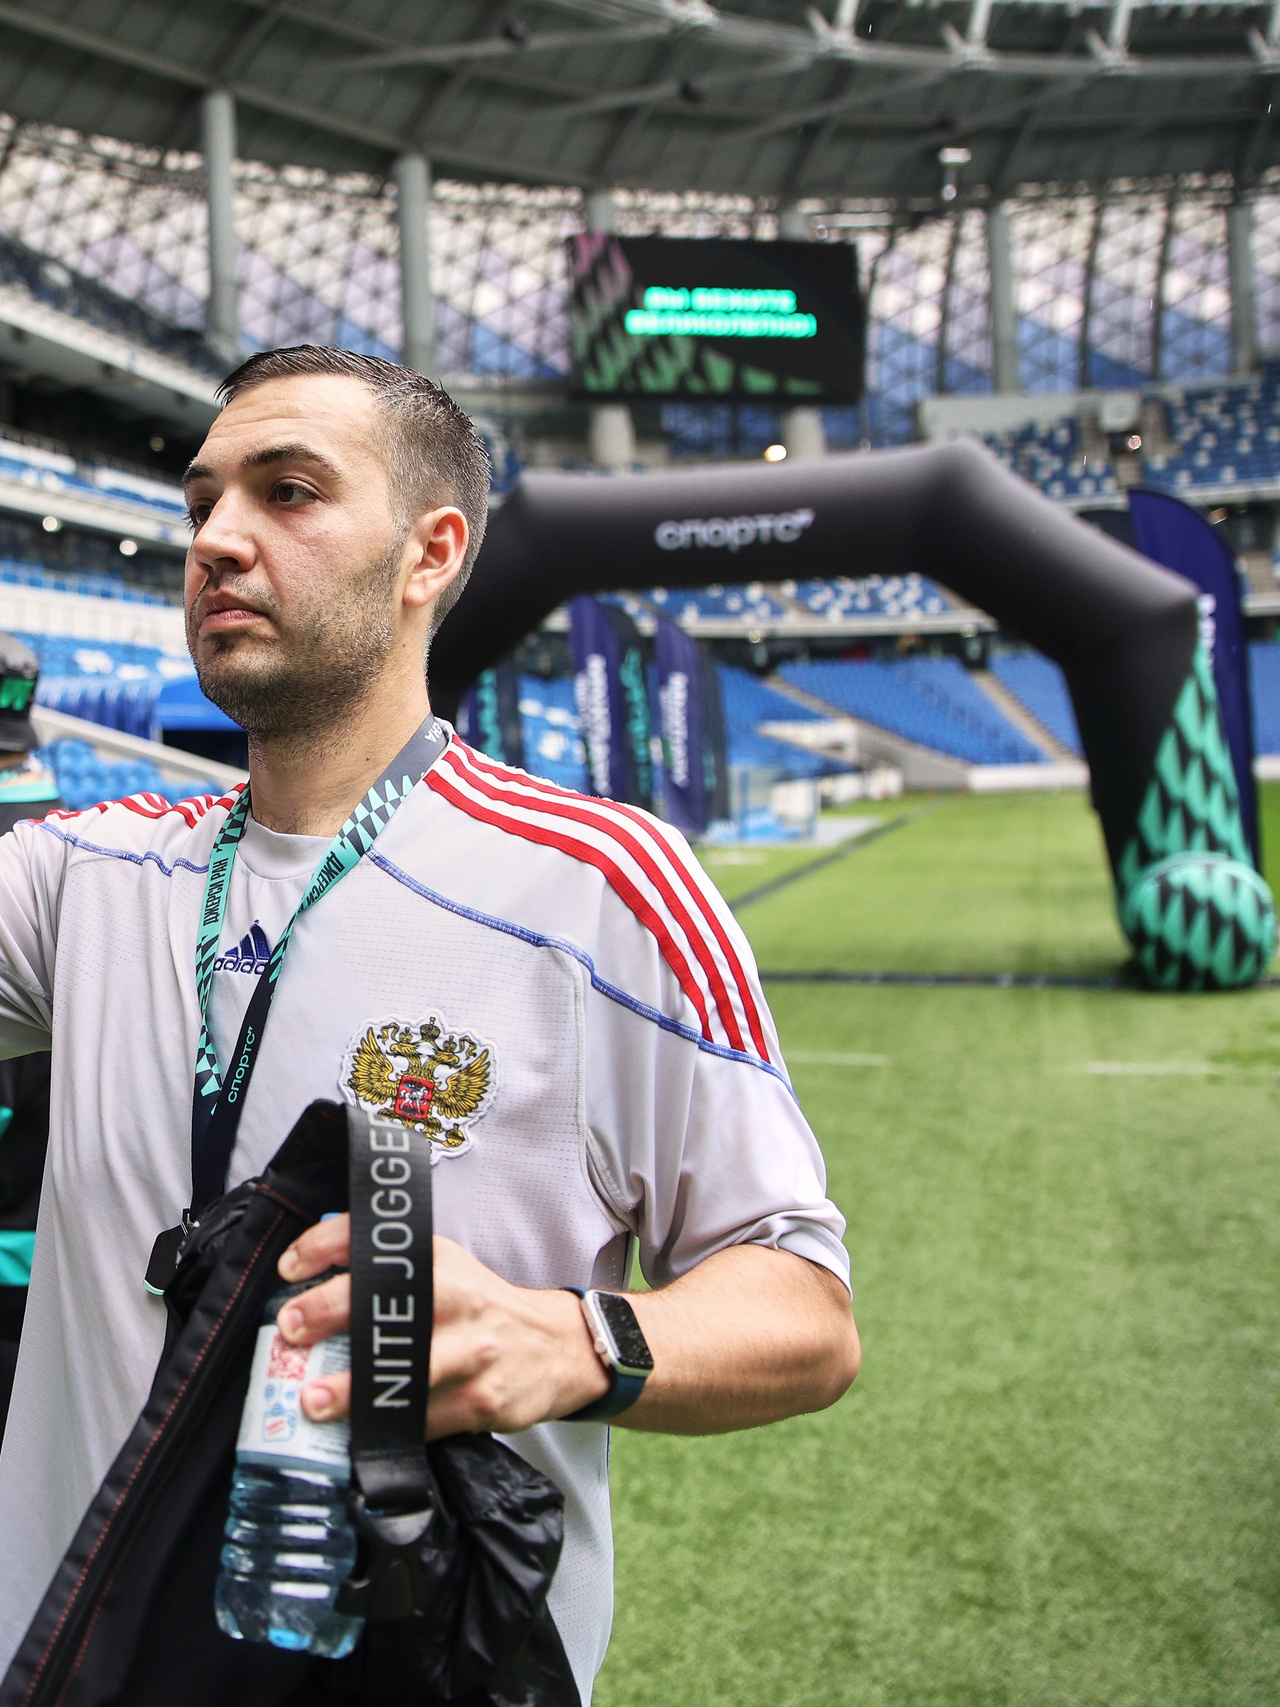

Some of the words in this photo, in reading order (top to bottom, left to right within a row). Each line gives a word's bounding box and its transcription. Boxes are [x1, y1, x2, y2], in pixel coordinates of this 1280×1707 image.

[210, 857, 228, 881] РАН
[306, 850, 345, 907] ДЖЕРСИ
[203, 879, 224, 926] ДЖЕРСИ
[372, 1293, 415, 1409] NITE
